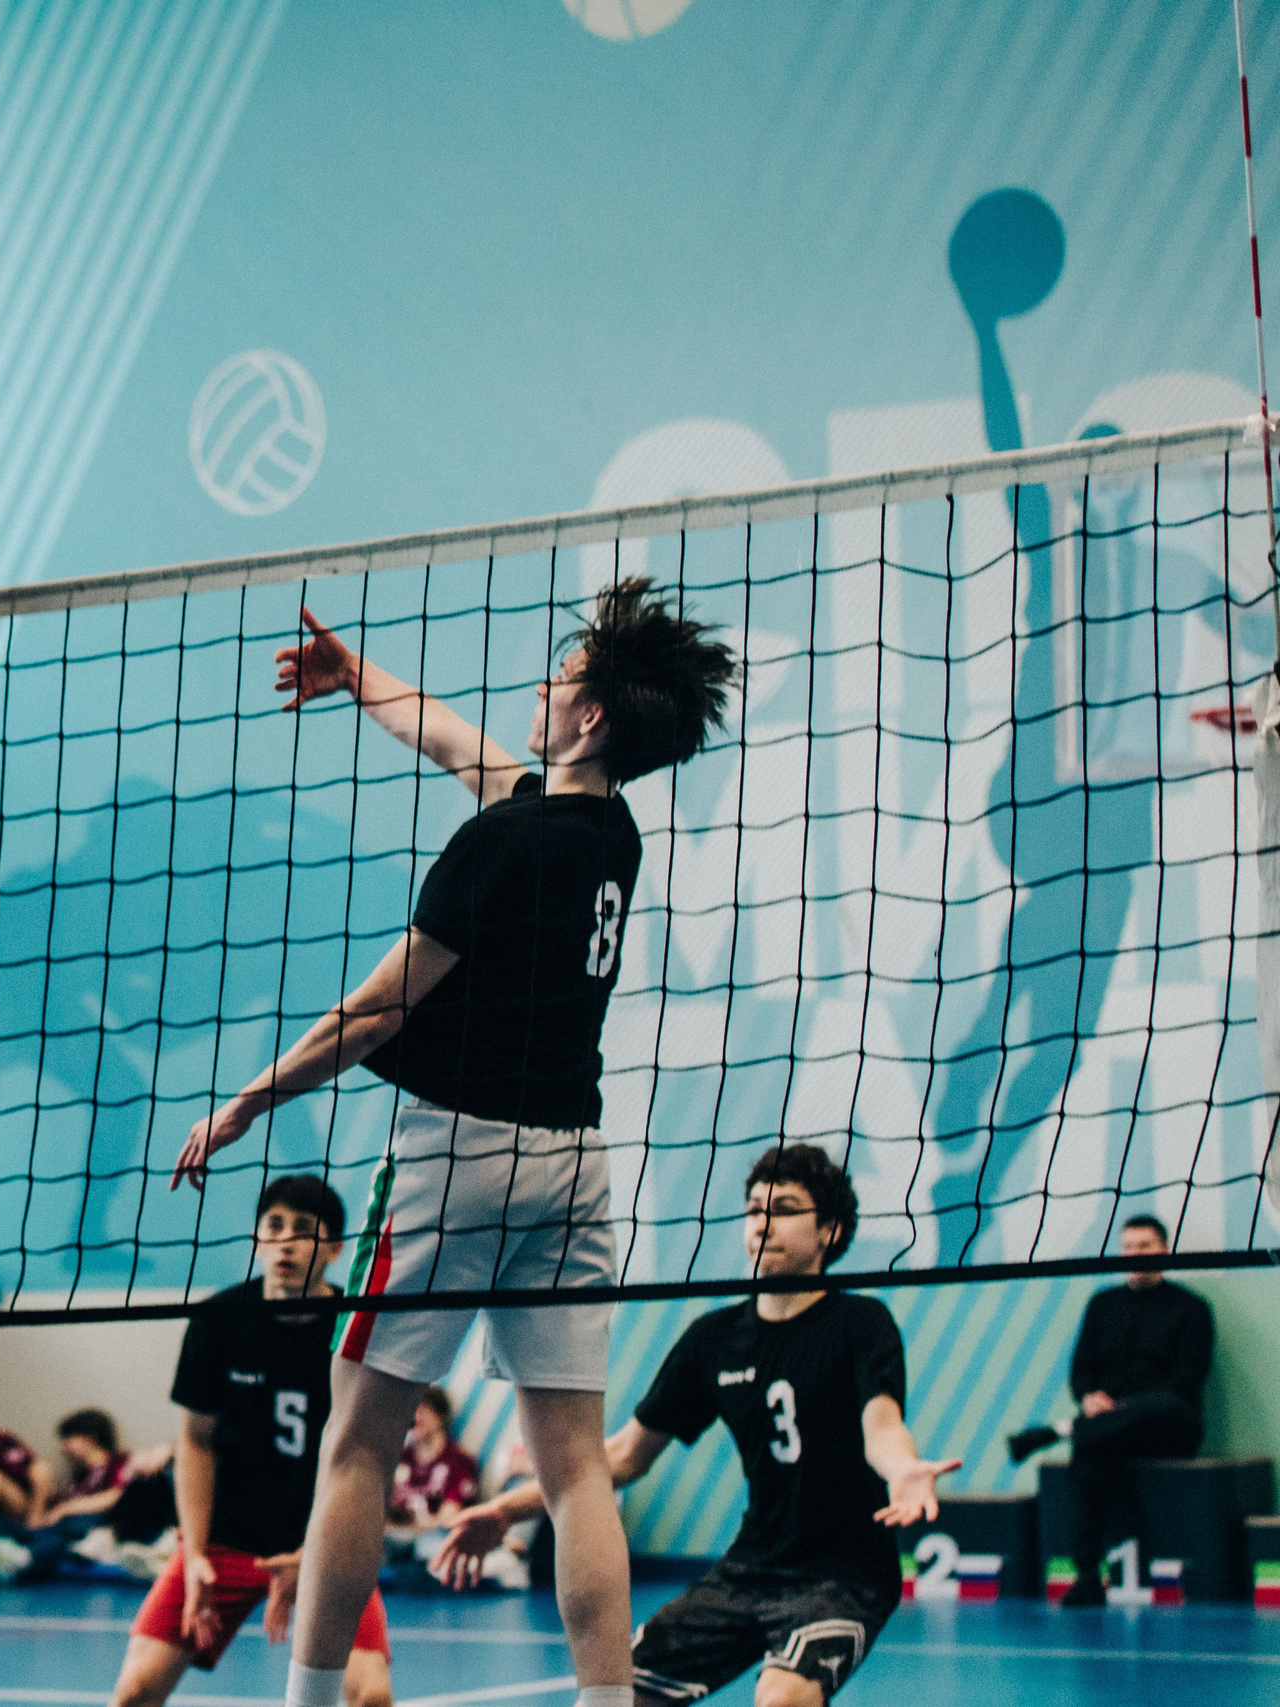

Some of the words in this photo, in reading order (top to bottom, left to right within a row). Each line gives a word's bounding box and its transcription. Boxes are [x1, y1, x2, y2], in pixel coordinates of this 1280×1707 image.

[586, 881, 621, 978] 8
[275, 1391, 307, 1457] 5
[766, 1379, 801, 1463] 3
[914, 1533, 959, 1600] 2
[1106, 1538, 1152, 1603] 1
